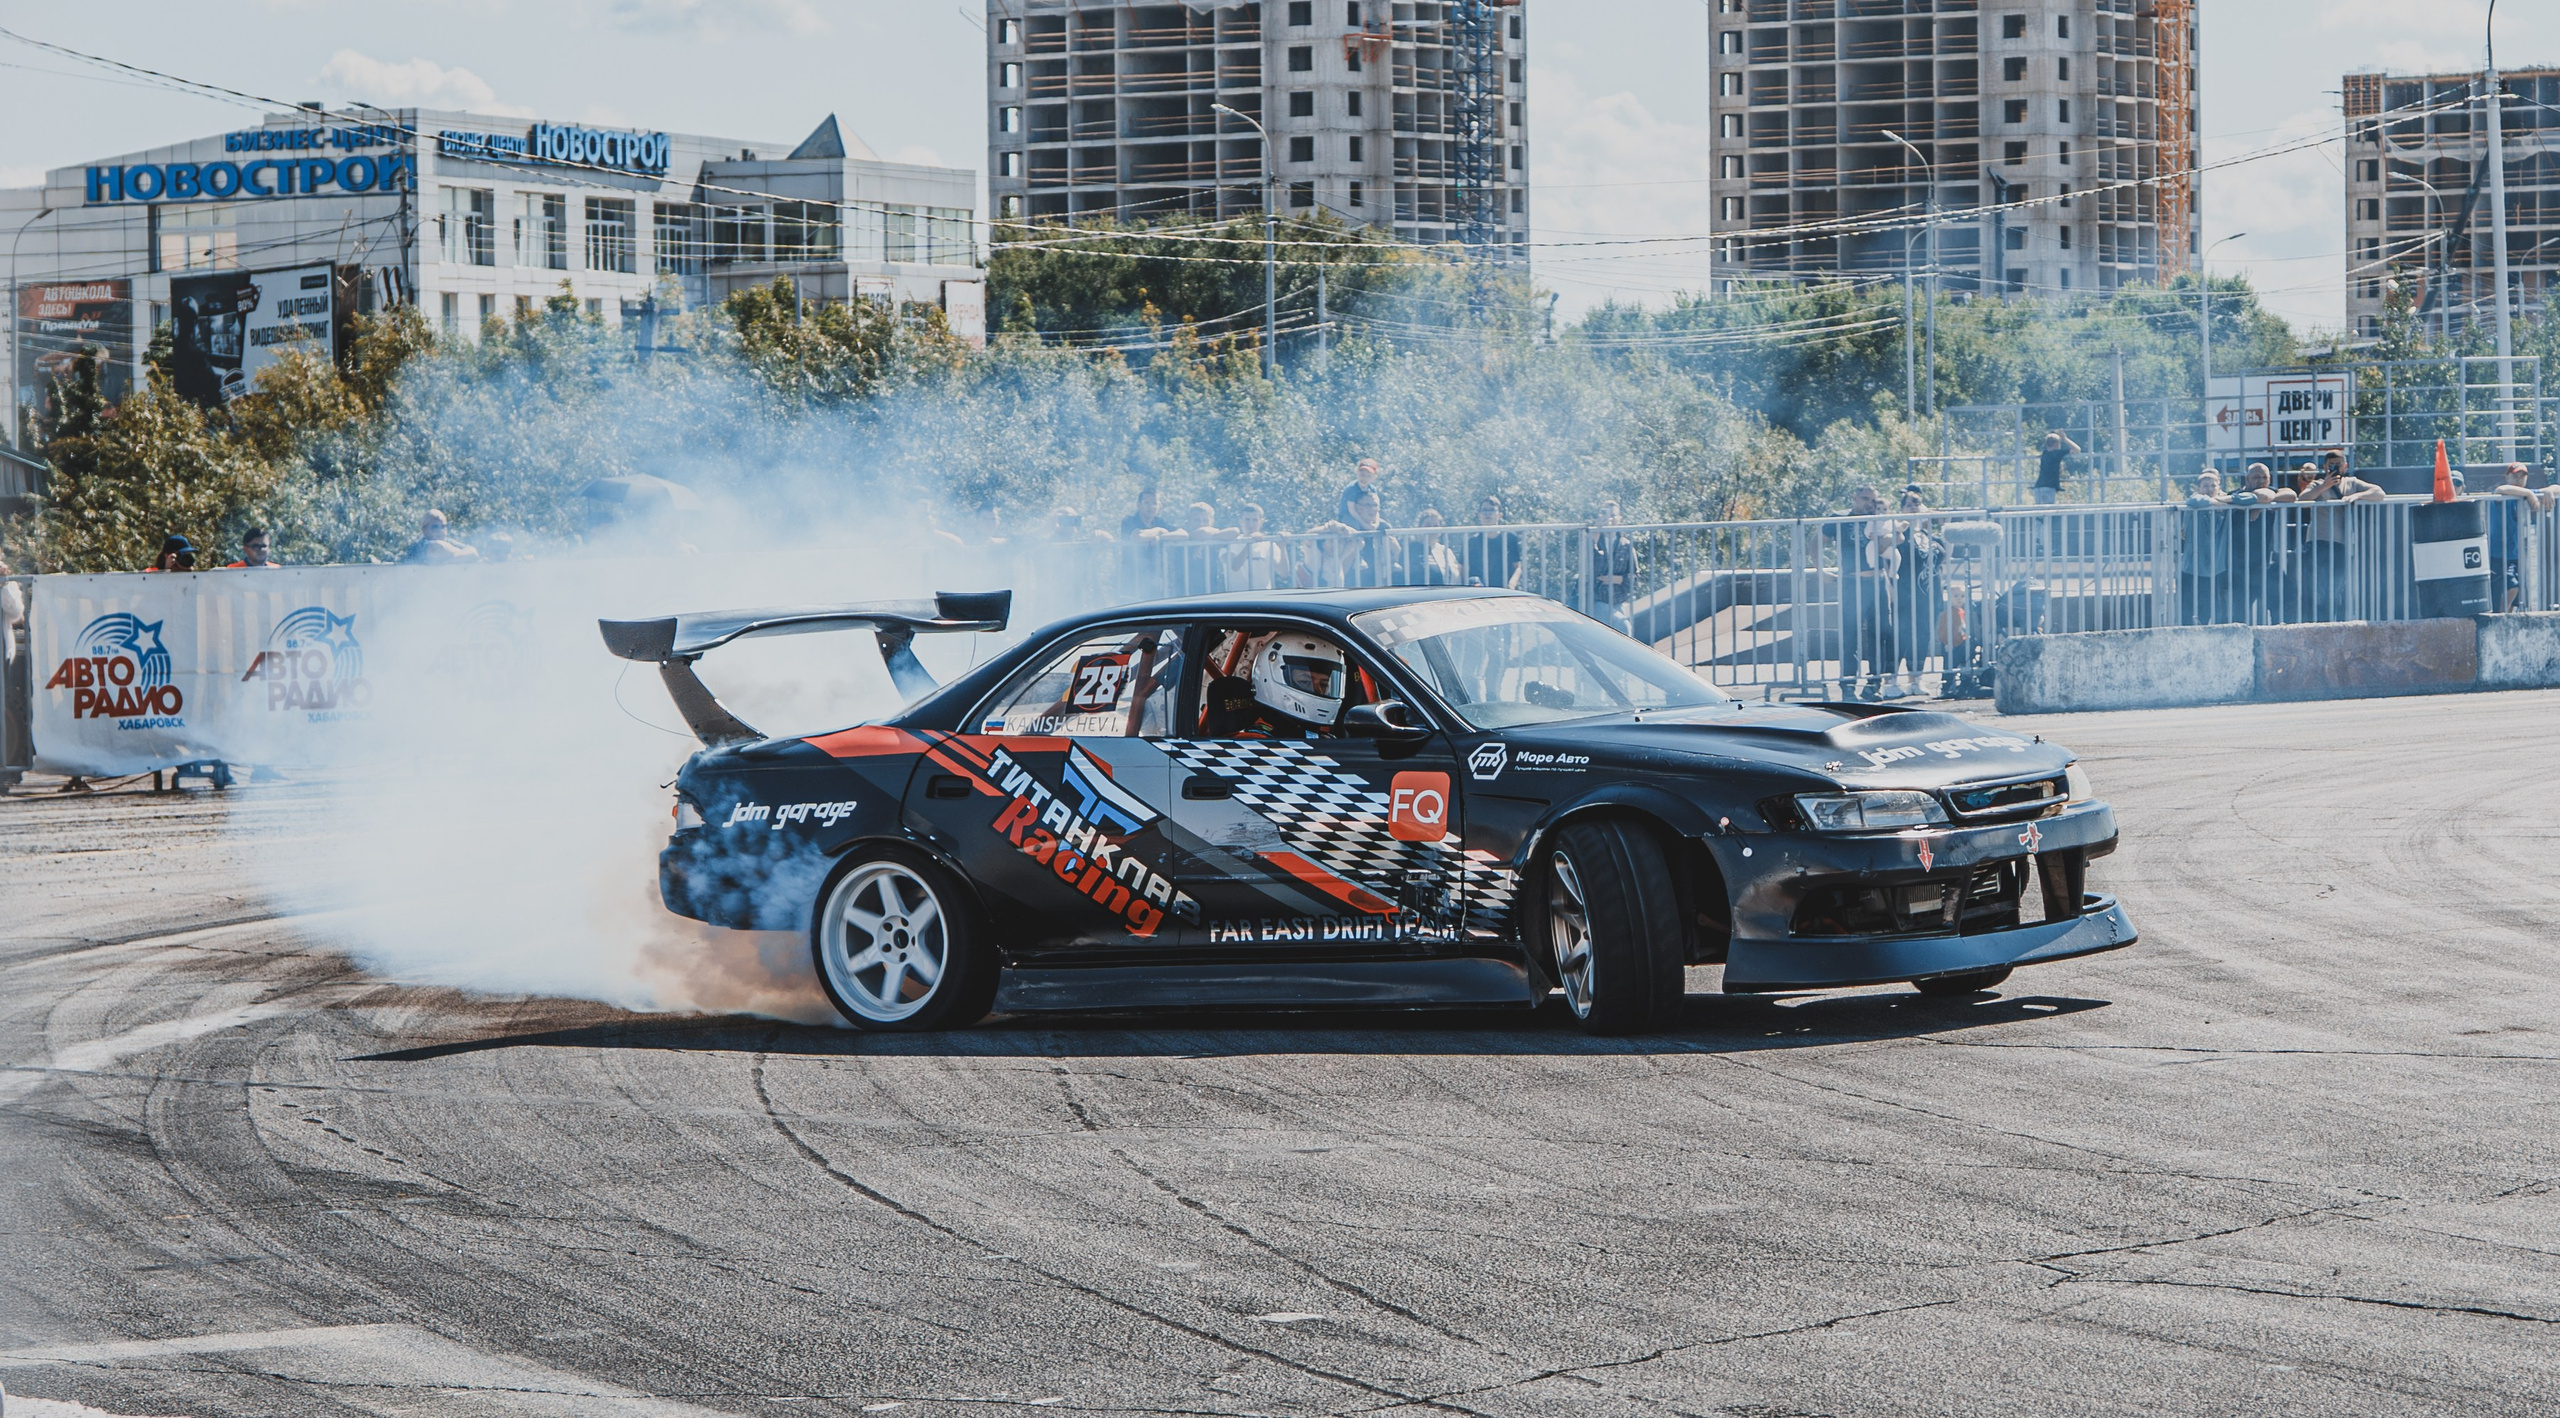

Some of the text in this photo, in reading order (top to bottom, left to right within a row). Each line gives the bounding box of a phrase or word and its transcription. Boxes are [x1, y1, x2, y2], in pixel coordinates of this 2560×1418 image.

[488, 134, 529, 160] ЦЕНТР
[85, 150, 417, 201] НОВОСТРОЙ
[43, 285, 112, 302] АВТОШКОЛА
[277, 291, 328, 318] УДАЛЕННЫЙ
[250, 320, 329, 347] ВИДЕОМОНОРИНГ
[2225, 411, 2260, 426] ЗДСЬ
[2464, 551, 2480, 564] FQ
[45, 656, 135, 690] АВТО
[241, 649, 328, 682] АВТО
[268, 678, 373, 712] РАДИО
[1073, 665, 1122, 705] 28
[74, 684, 183, 719] РАДИО
[118, 718, 186, 731] ХАБАРОВСК
[1006, 715, 1111, 732] KANISHCHEV
[1516, 751, 1590, 765] Море Авто
[1857, 736, 2031, 772] jdm garage
[722, 800, 857, 831] jdm garage
[1391, 788, 1444, 824] FQ
[992, 793, 1164, 939] Racing
[1208, 919, 1254, 942] FAR
[1260, 917, 1316, 941] EAST
[1321, 915, 1384, 940] DRIFT
